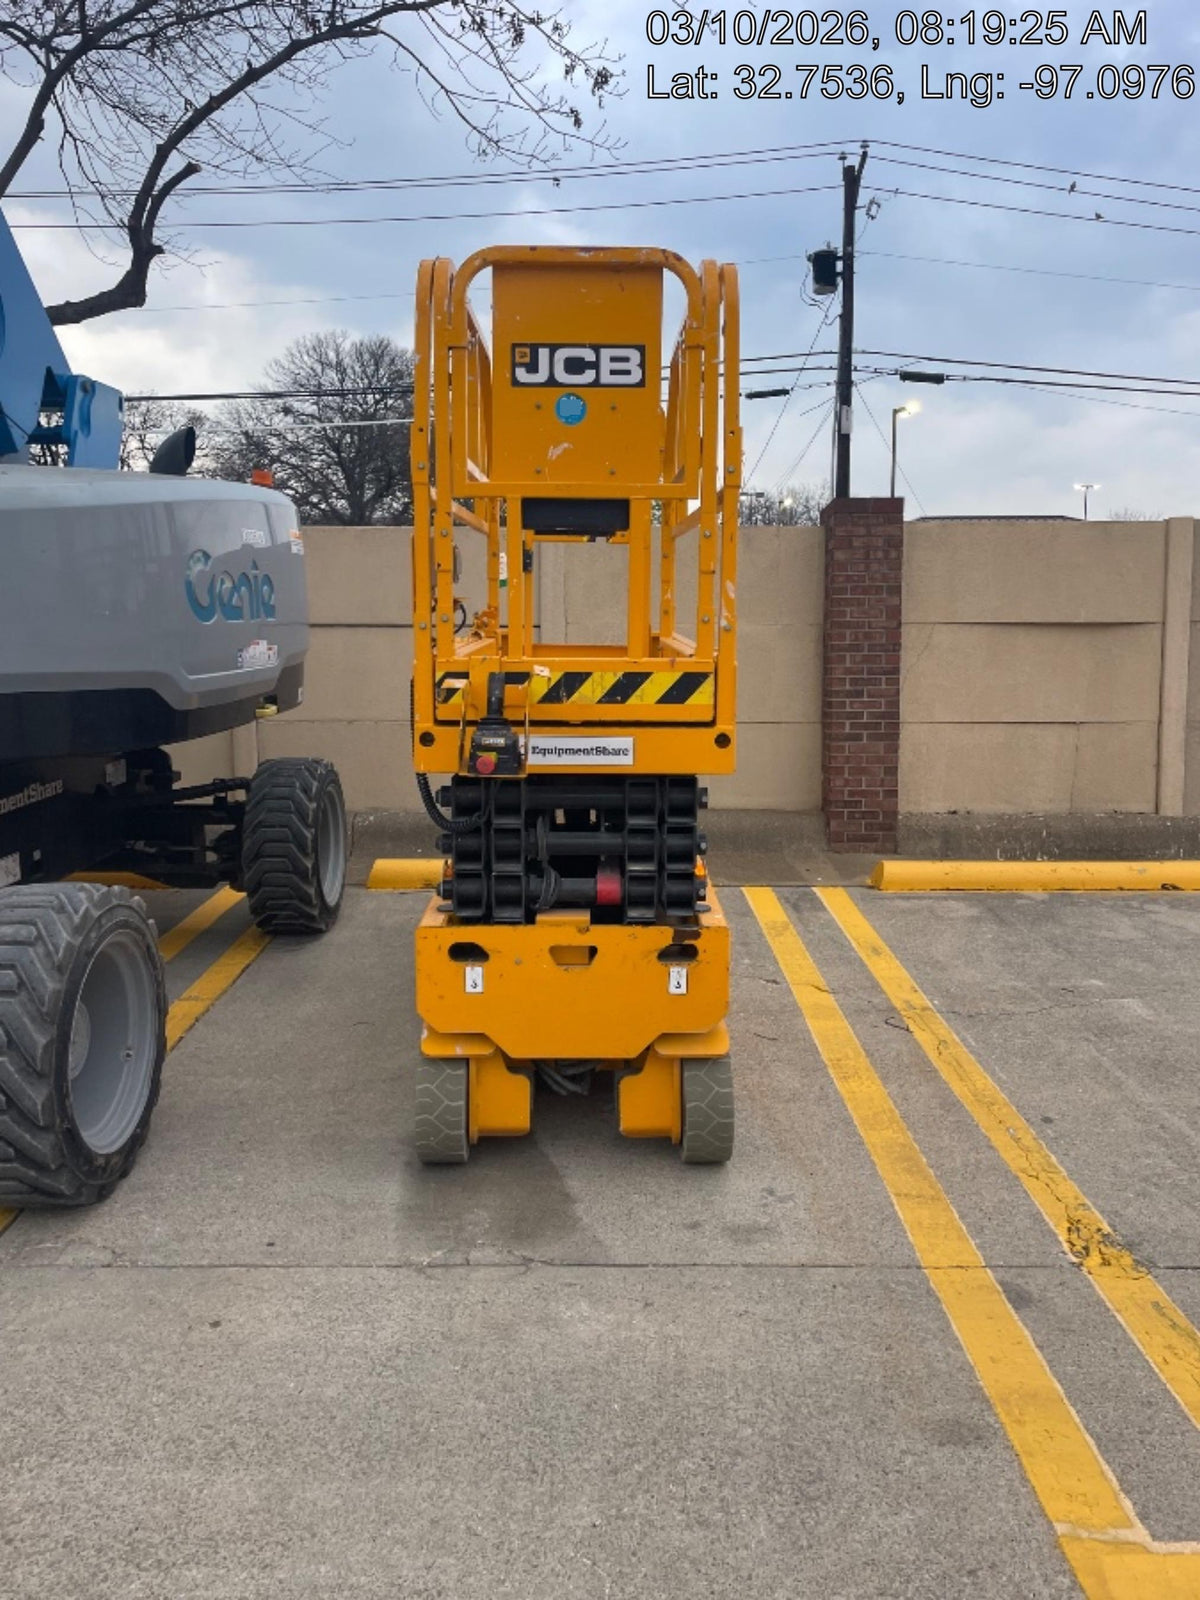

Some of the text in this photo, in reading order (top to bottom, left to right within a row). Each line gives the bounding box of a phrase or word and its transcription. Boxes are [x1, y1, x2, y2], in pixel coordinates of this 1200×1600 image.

[515, 347, 643, 385] JCB
[185, 549, 276, 624] Genie
[531, 745, 630, 758] EquipmentShare
